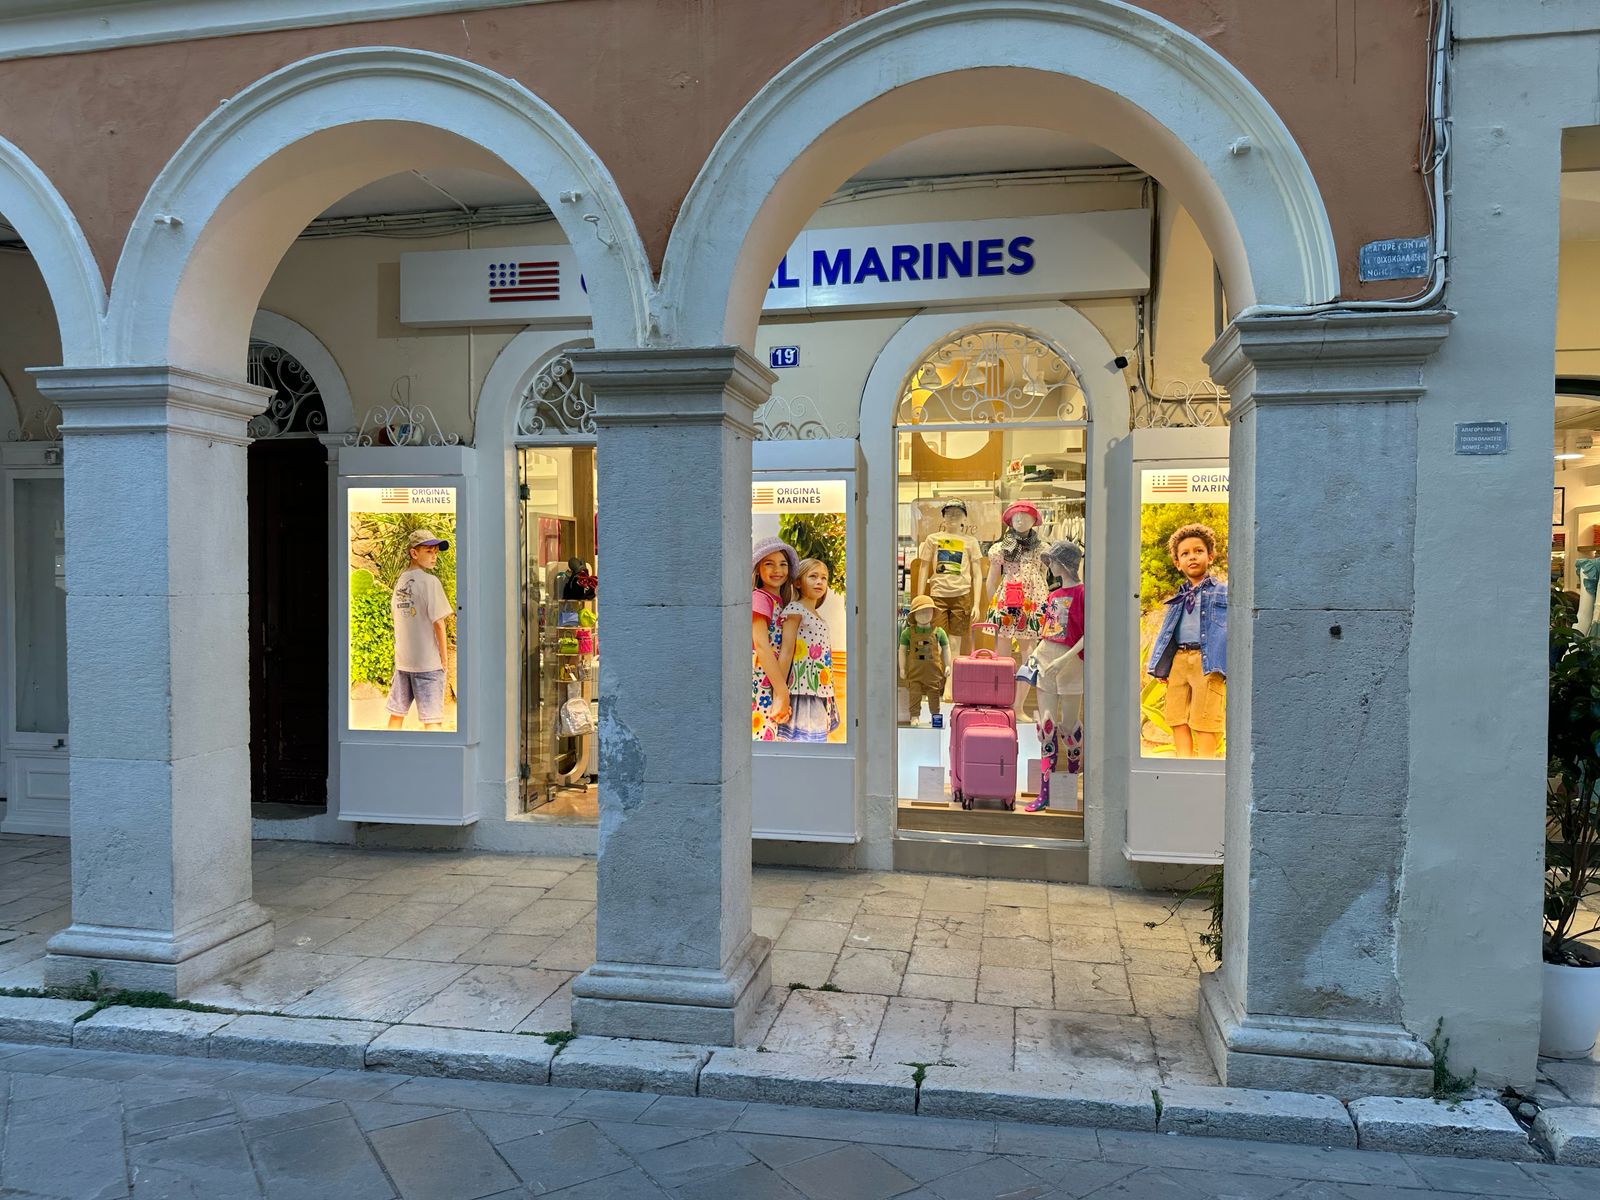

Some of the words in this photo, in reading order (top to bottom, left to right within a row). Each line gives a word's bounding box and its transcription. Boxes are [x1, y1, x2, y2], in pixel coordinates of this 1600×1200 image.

[812, 236, 1035, 287] MARINES
[776, 349, 796, 365] 19
[412, 488, 450, 496] ORIGINAL
[777, 487, 821, 495] ORIGINAL
[777, 496, 821, 504] MARINES
